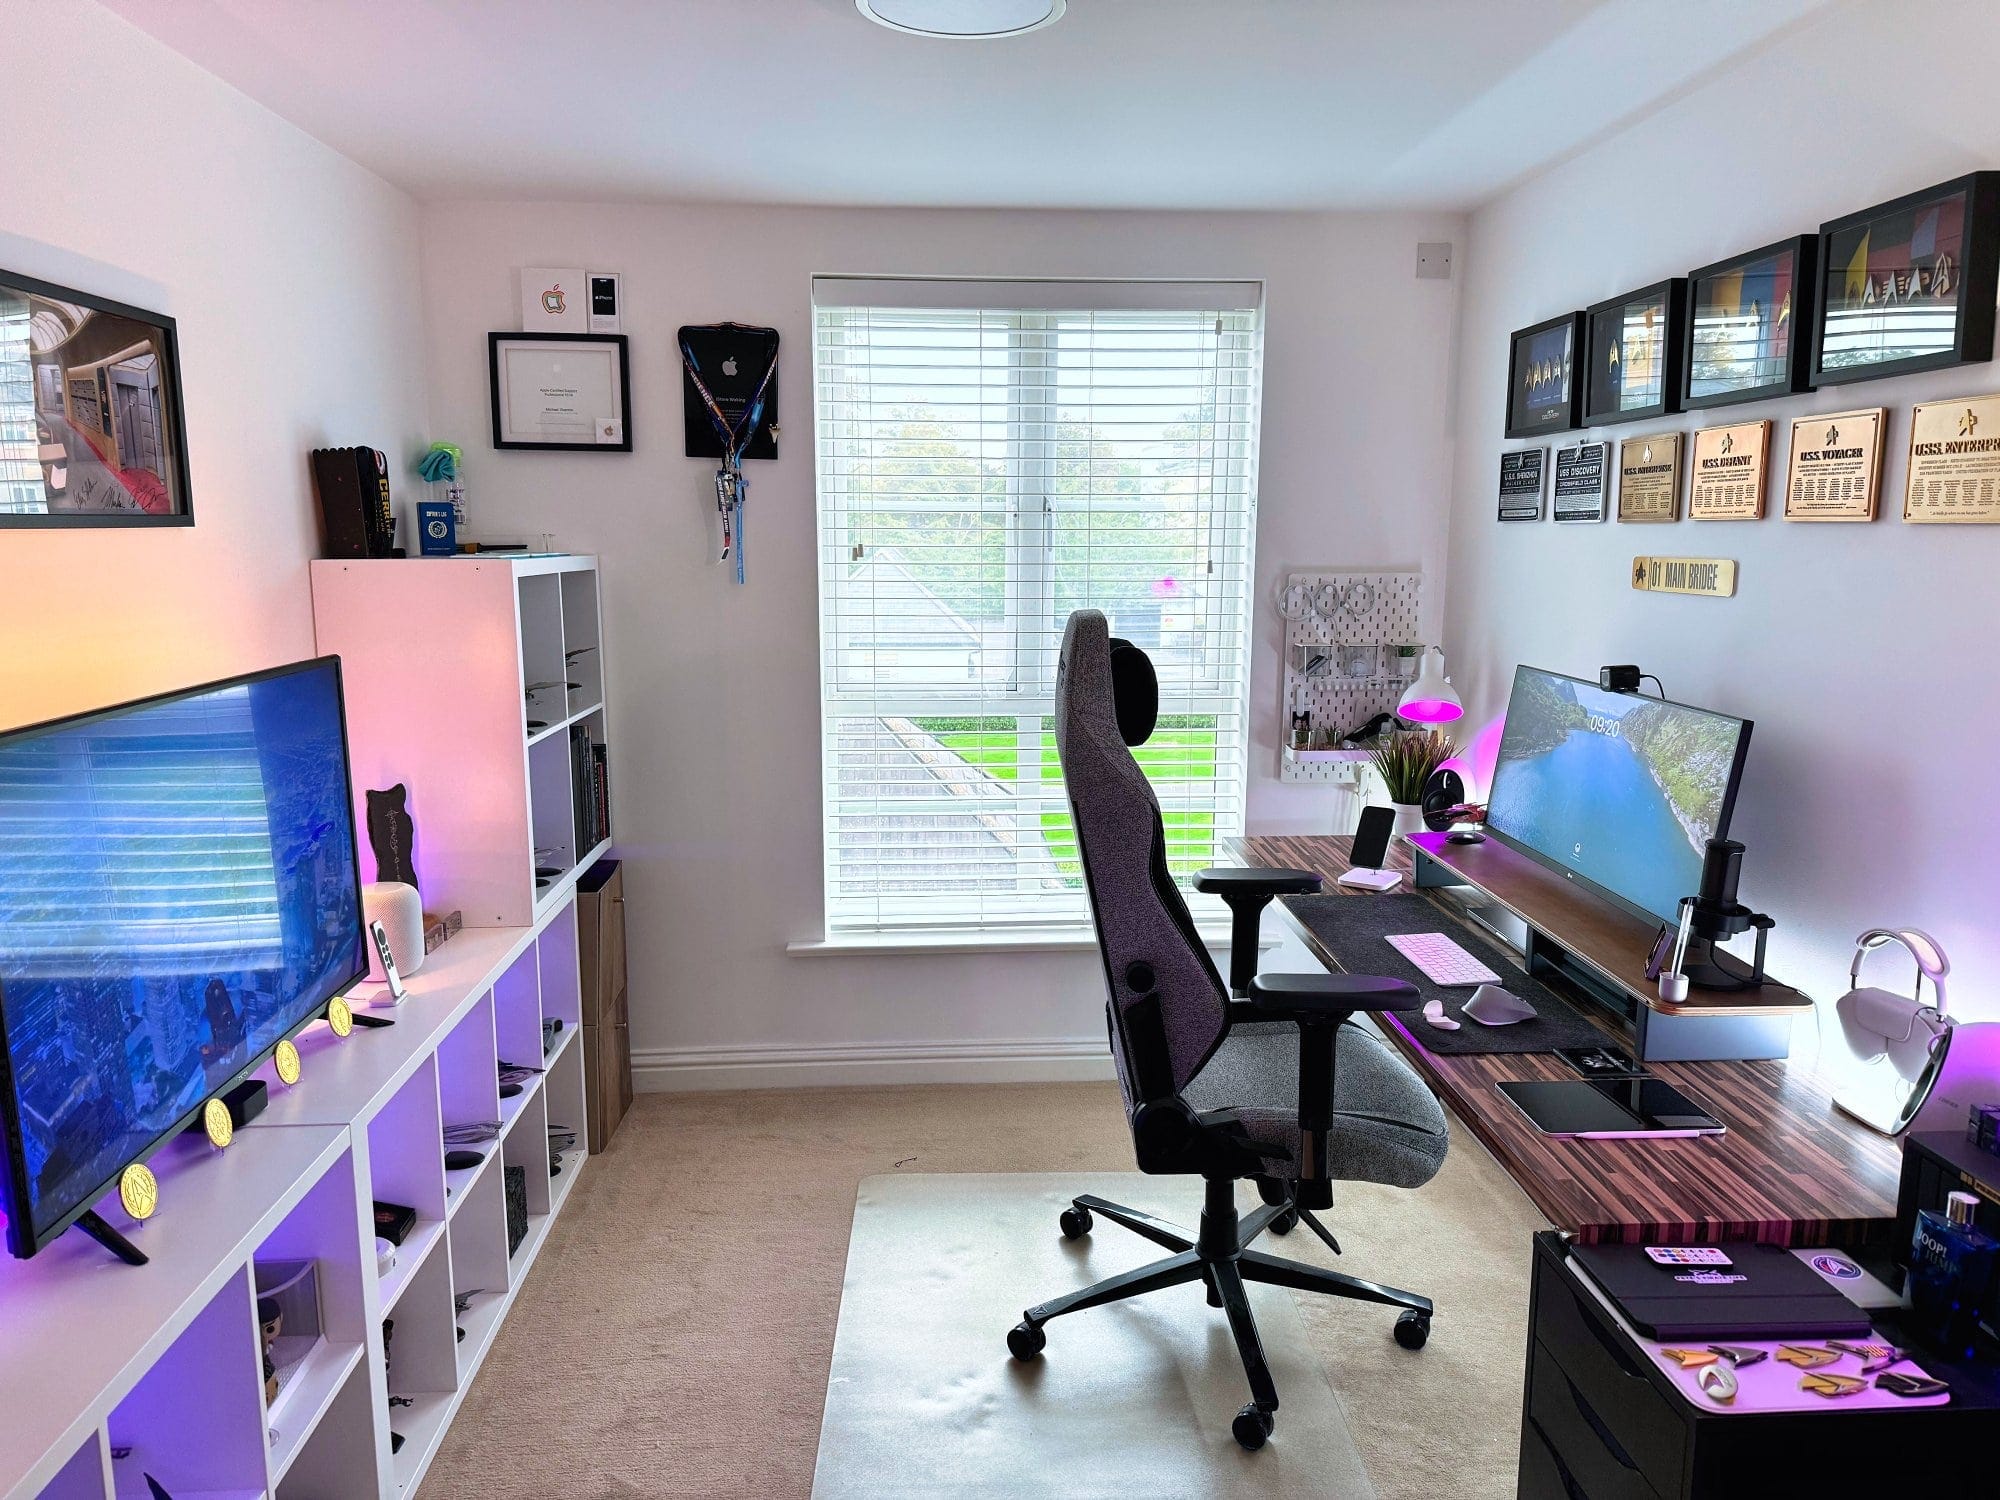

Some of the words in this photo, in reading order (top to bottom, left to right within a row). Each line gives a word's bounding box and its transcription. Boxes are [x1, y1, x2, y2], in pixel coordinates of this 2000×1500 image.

[1720, 455, 1753, 468] DEFIANT
[1821, 447, 1864, 460] VOYAGER
[1570, 465, 1600, 476] DISCOVERY
[1651, 561, 1662, 588] 01
[1664, 562, 1687, 589] MAIN
[1688, 563, 1719, 591] BRIDGE
[1590, 714, 1620, 738] 09:20
[1916, 1230, 1948, 1258] JOOP!
